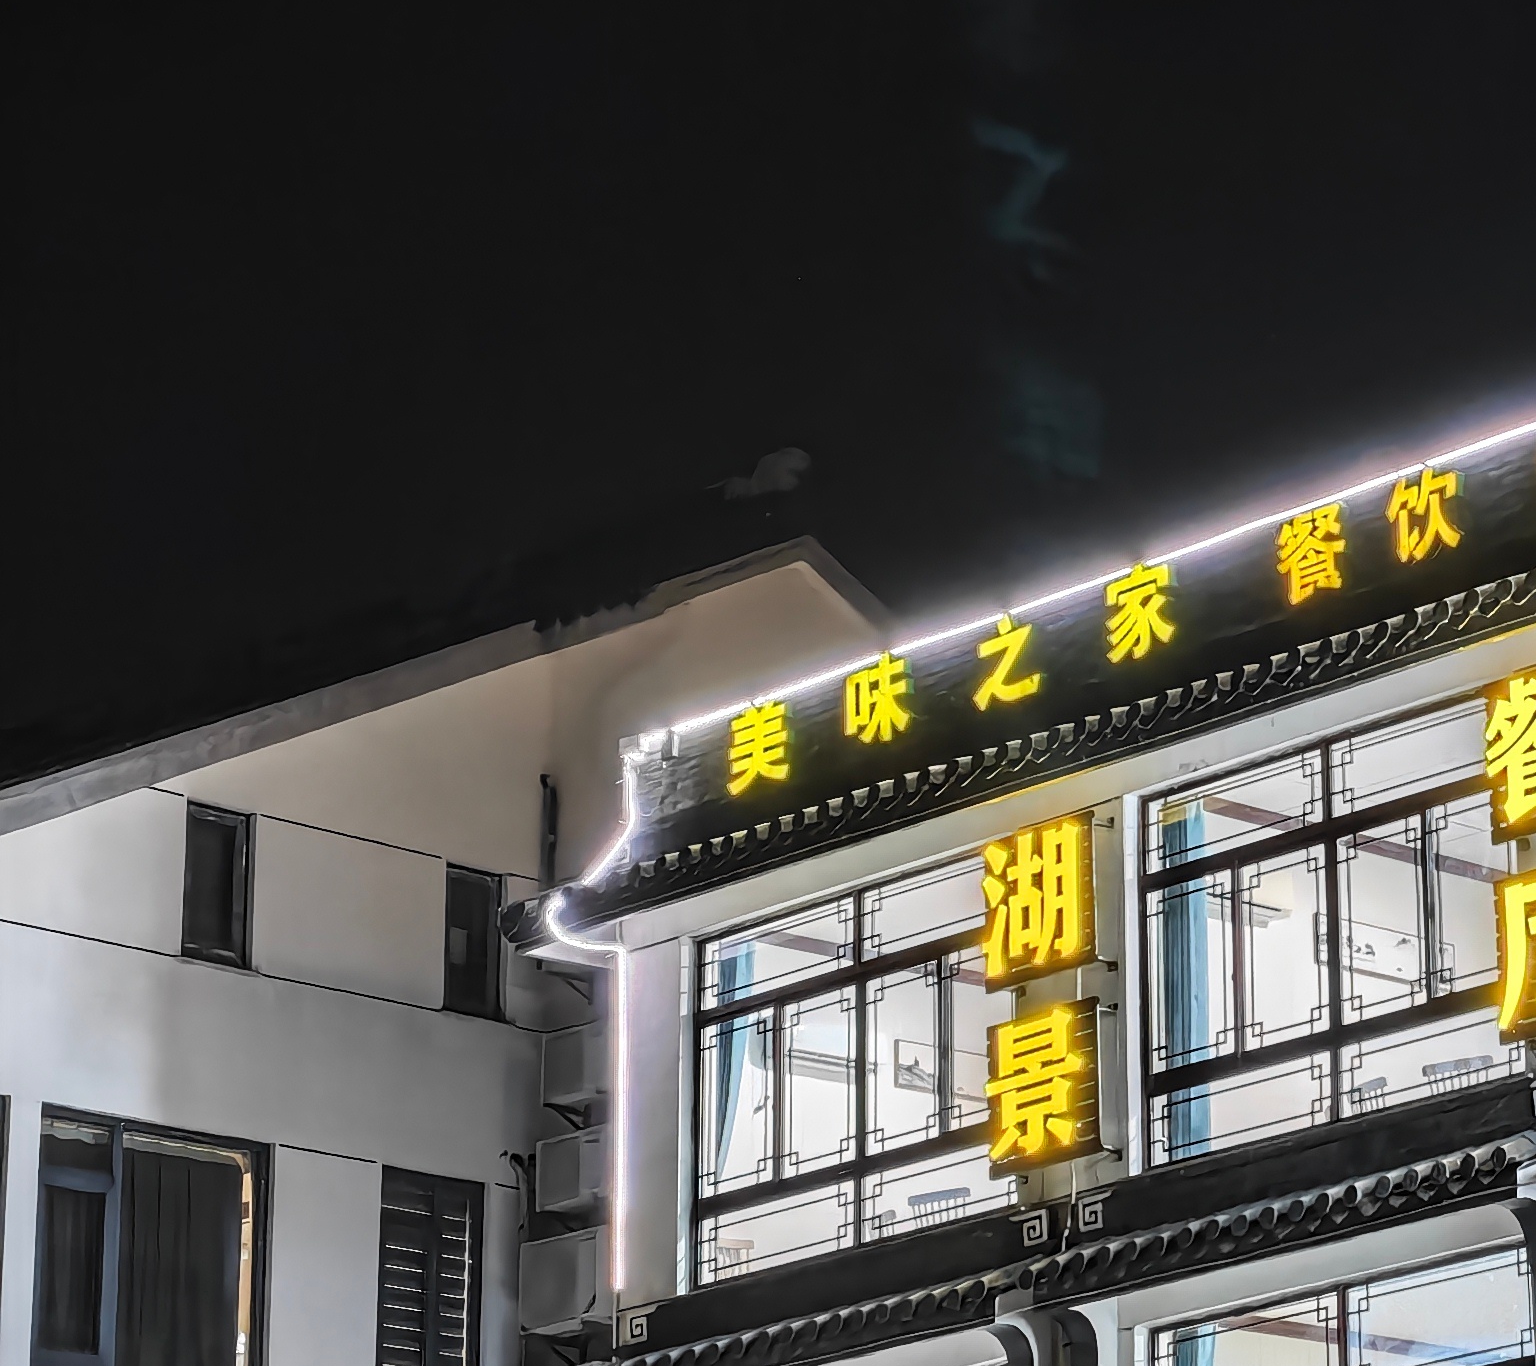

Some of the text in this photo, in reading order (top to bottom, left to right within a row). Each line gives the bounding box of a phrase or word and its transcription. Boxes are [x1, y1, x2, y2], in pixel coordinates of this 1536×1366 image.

[726, 561, 1176, 803] 美味之家
[1275, 468, 1464, 607] 餐饮
[980, 815, 1083, 1161] 湖景
